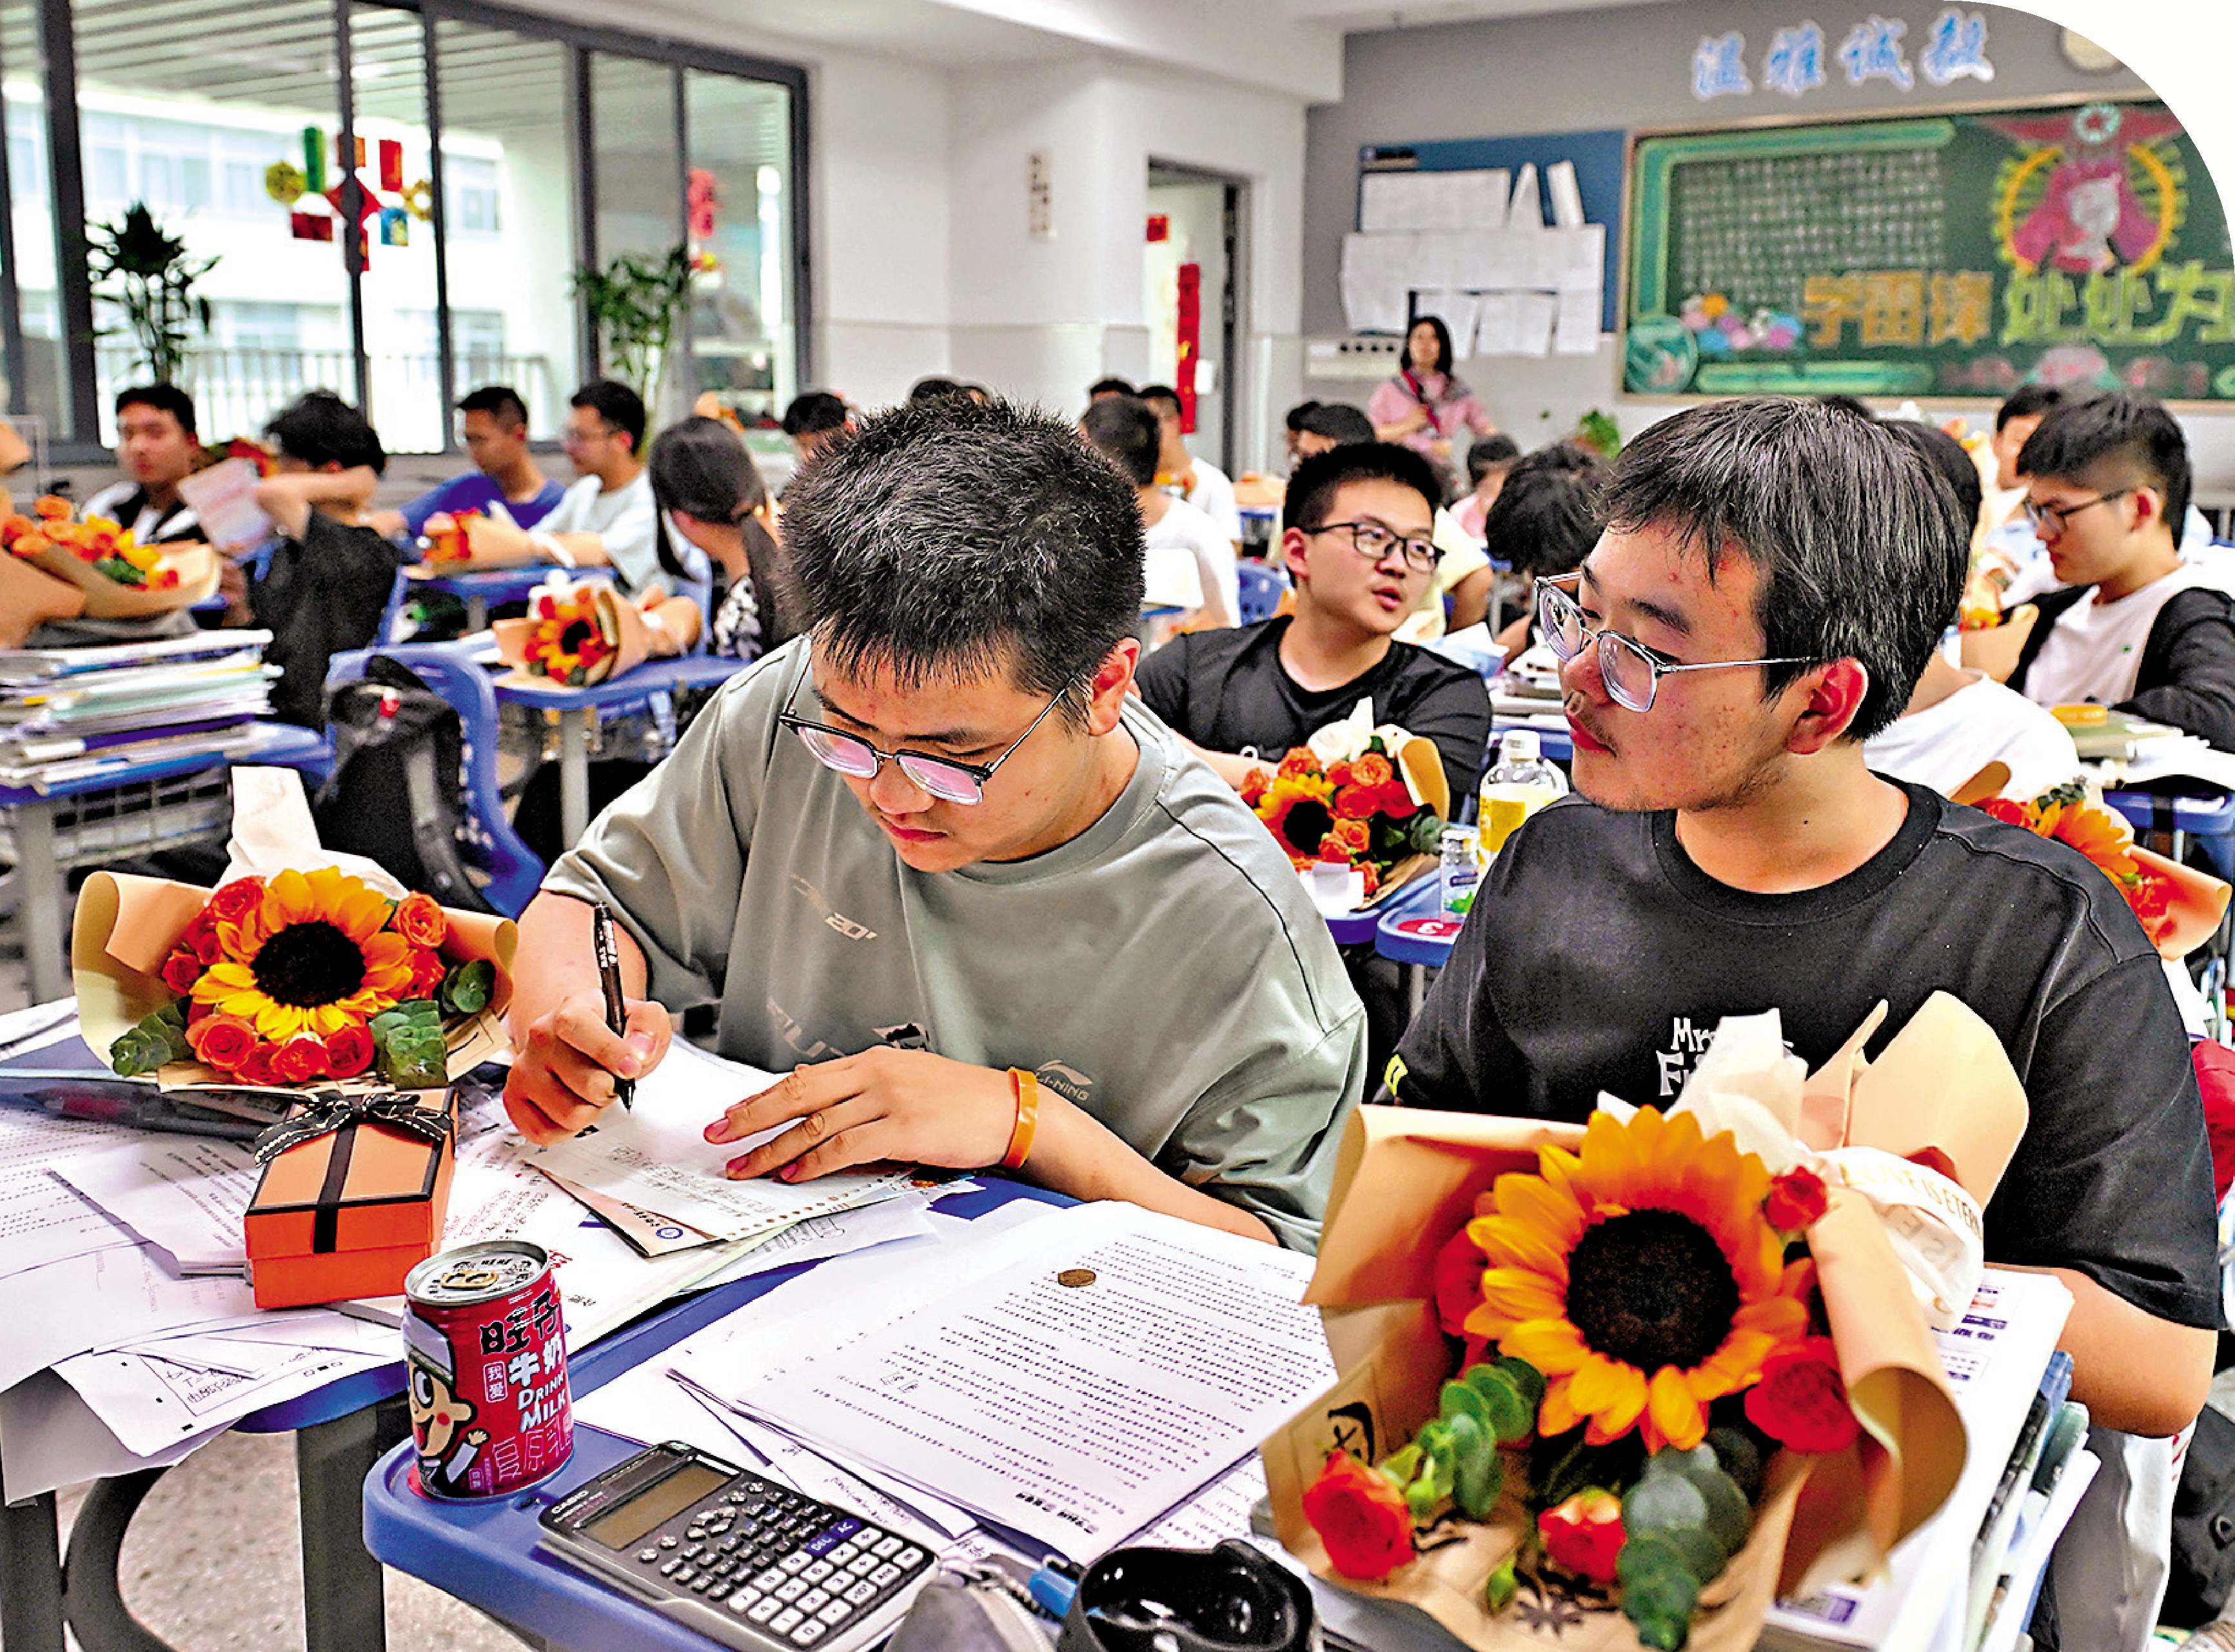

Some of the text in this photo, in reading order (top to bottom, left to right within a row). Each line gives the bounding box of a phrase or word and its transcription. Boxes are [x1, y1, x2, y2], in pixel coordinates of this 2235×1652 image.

[479, 1289, 558, 1355] 旺仔
[507, 1332, 562, 1388] 牛奶
[520, 1388, 567, 1433] MILK
